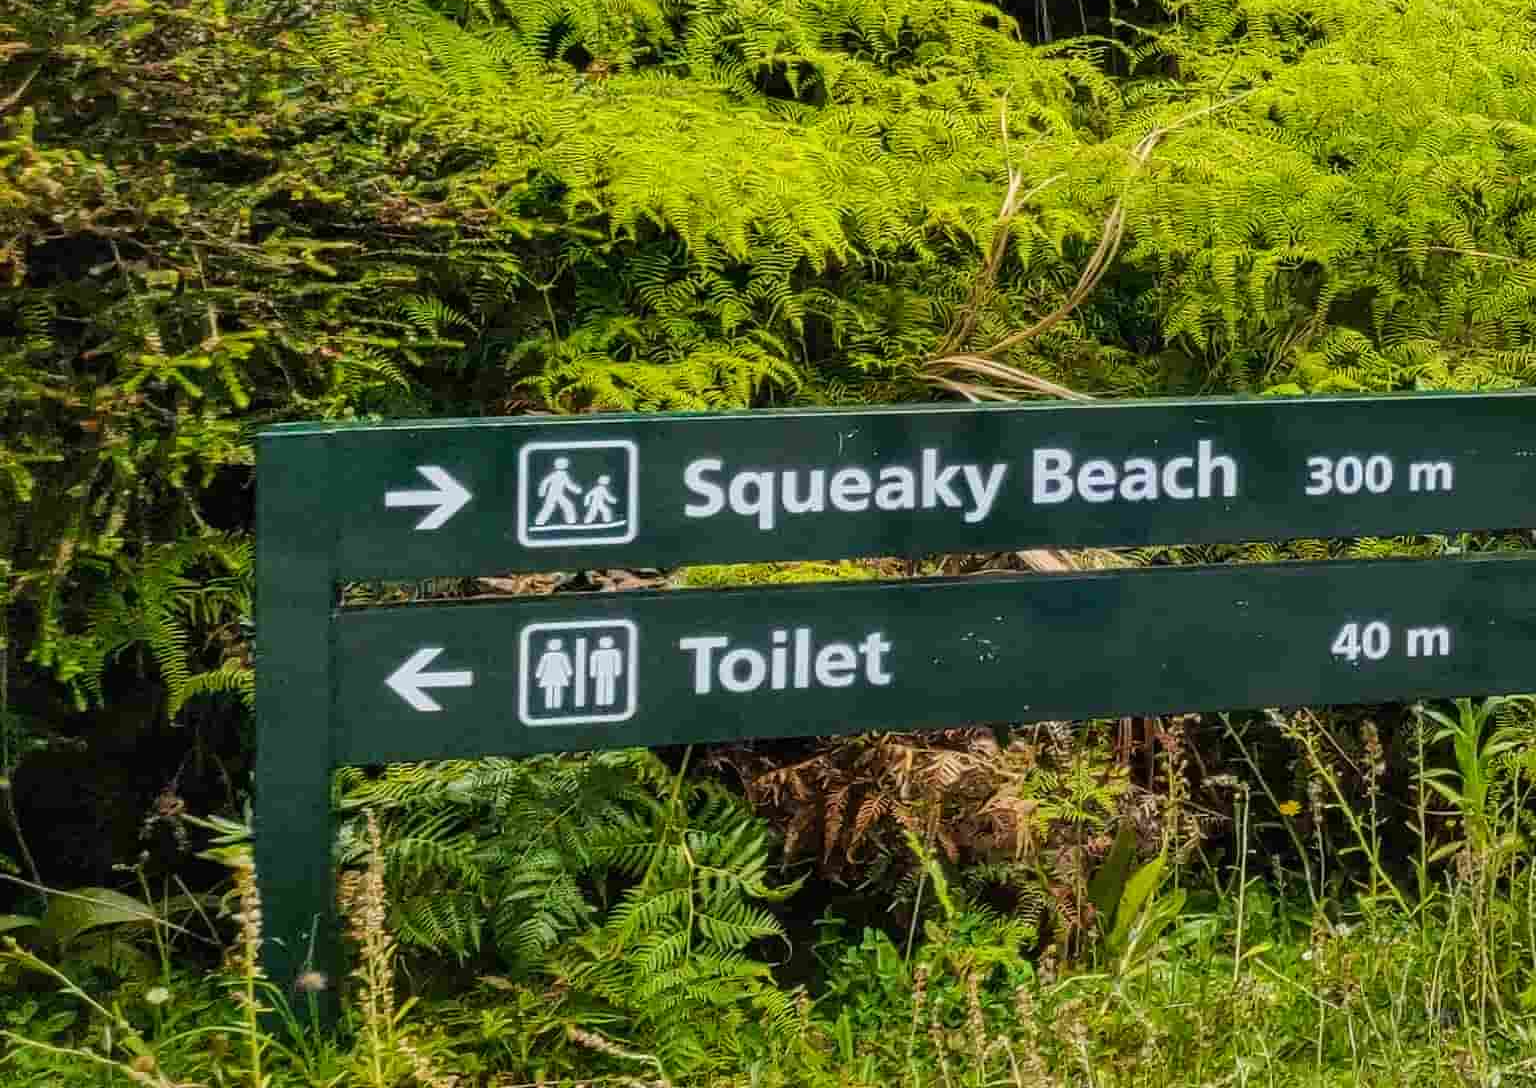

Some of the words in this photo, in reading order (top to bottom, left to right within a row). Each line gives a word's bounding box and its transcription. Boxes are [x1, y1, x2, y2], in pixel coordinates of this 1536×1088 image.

[684, 448, 1007, 528] Squeaky
[1031, 440, 1238, 507] Beach
[1304, 456, 1392, 495] 300
[1408, 460, 1453, 490] m
[679, 628, 892, 695] Toilet
[1330, 622, 1391, 662] 40
[1406, 626, 1450, 658] m
